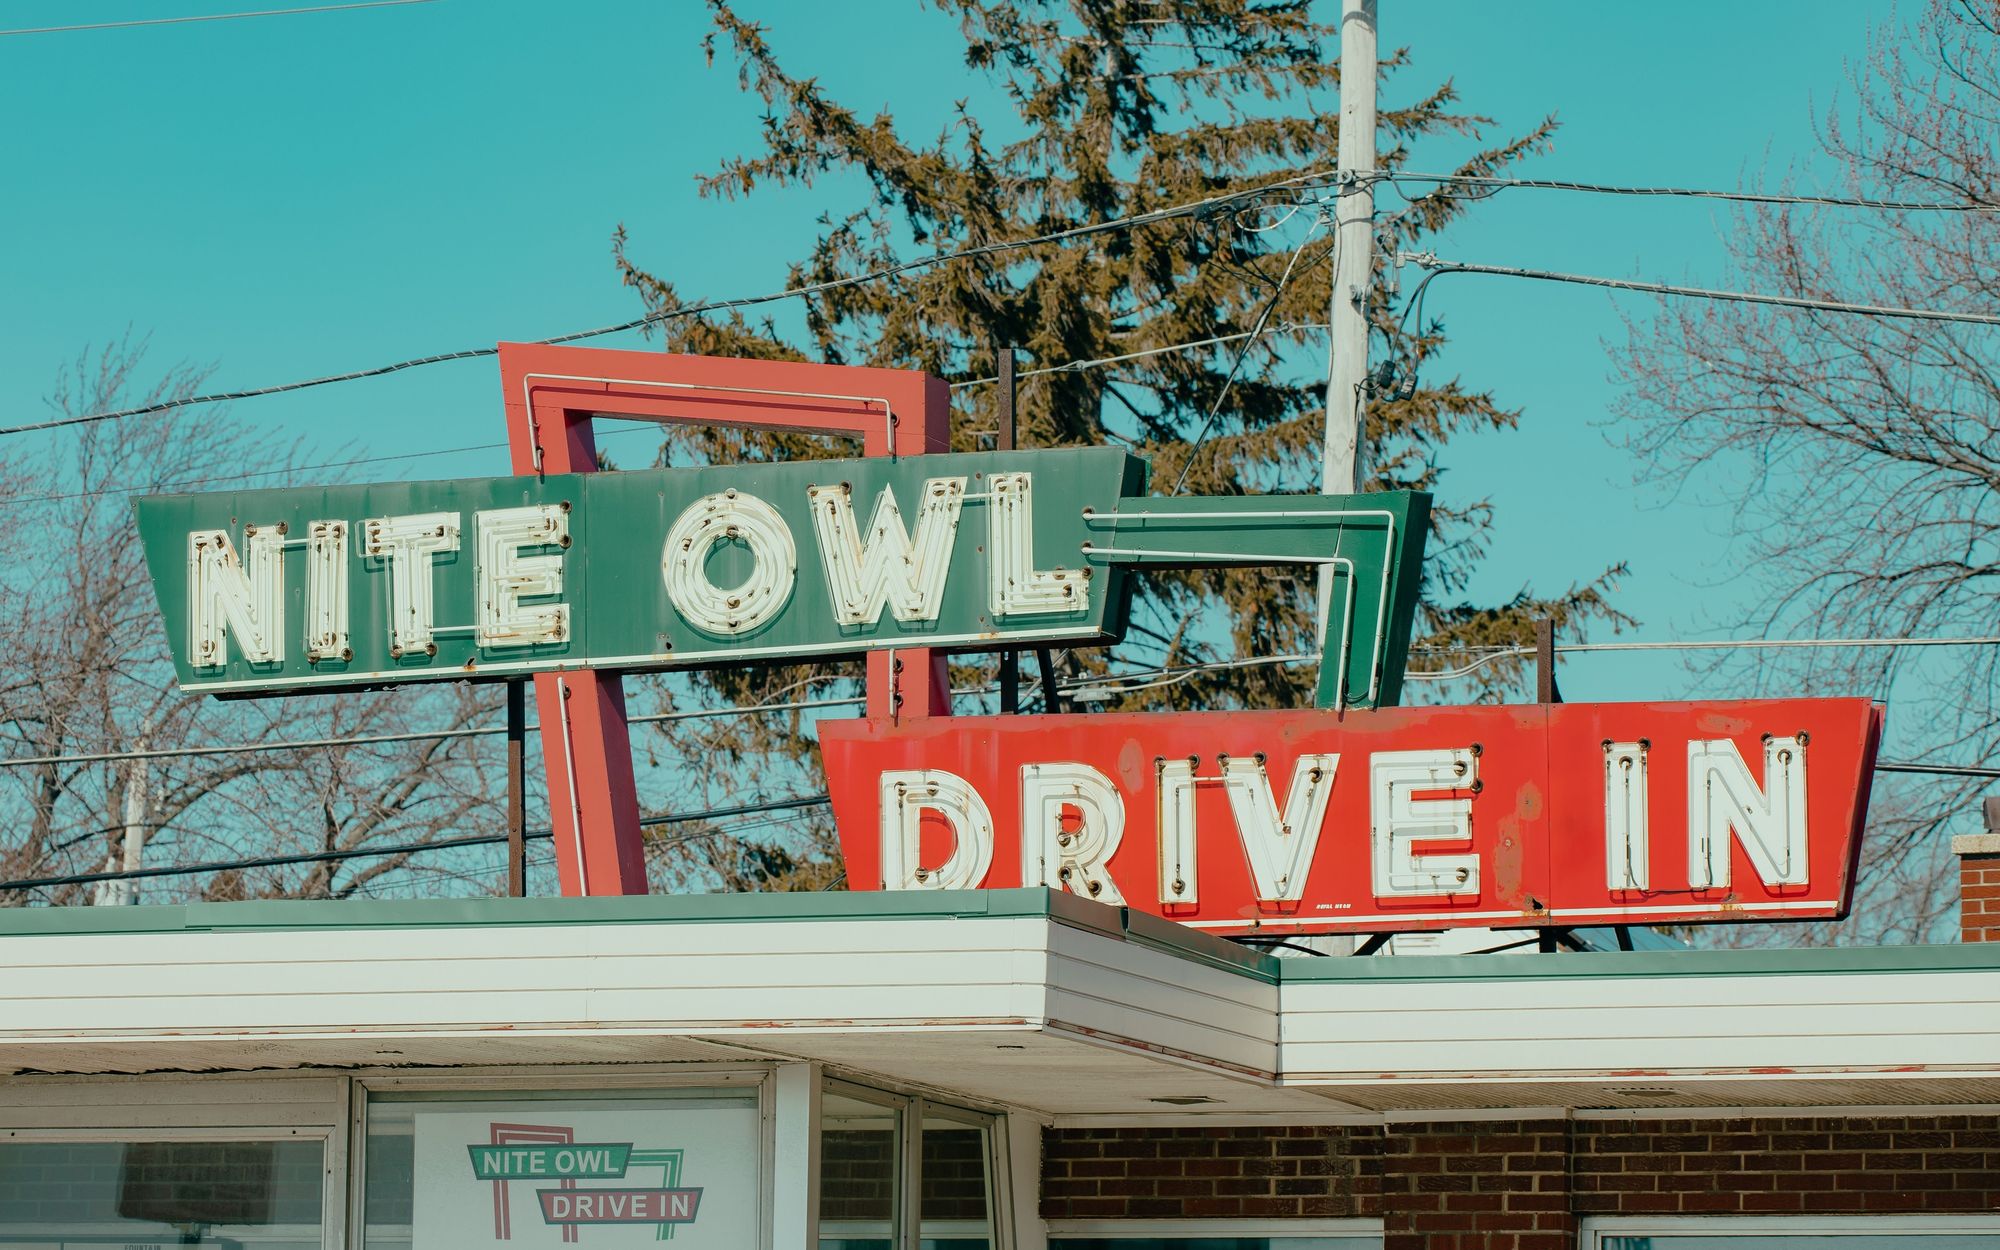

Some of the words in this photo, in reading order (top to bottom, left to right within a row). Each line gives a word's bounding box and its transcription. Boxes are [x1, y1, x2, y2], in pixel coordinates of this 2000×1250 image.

[187, 504, 571, 667] NITE
[662, 472, 1091, 634] OWL
[880, 748, 1480, 906] DRIVE
[1605, 737, 1809, 890] IN
[484, 1152, 546, 1173] NITE
[555, 1151, 620, 1173] OWL
[553, 1196, 647, 1218] DRIVE
[661, 1195, 689, 1217] IN
